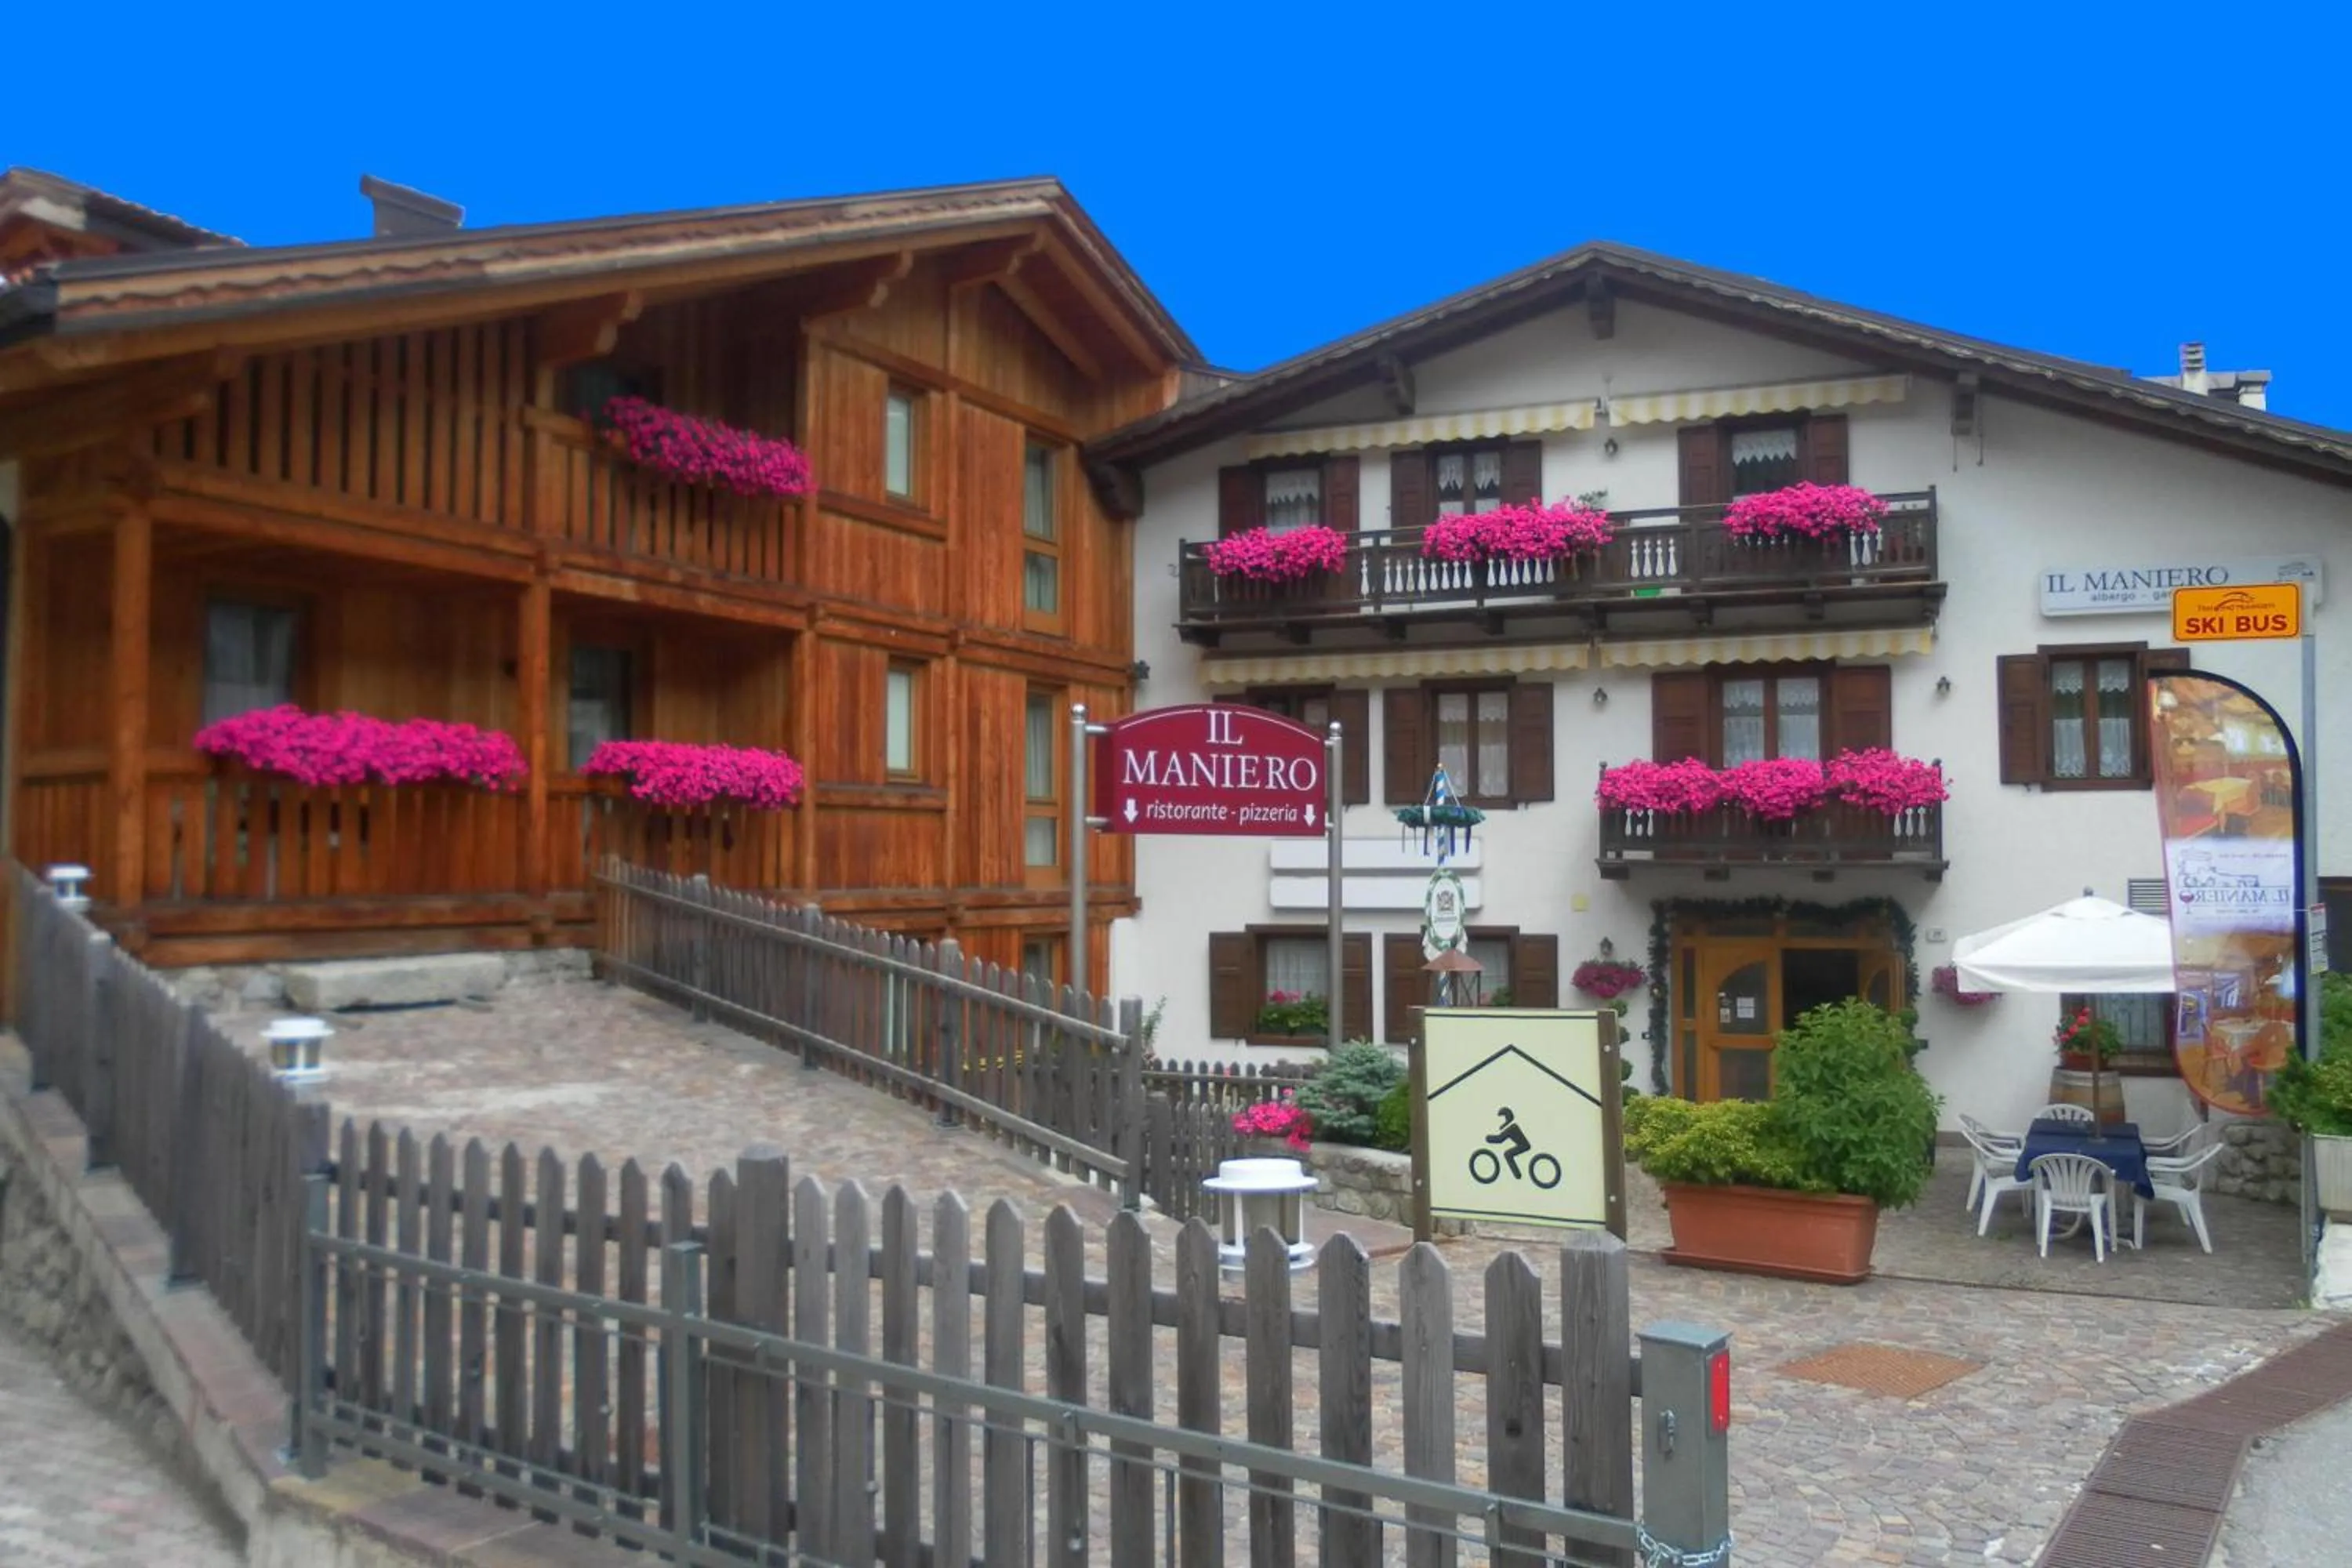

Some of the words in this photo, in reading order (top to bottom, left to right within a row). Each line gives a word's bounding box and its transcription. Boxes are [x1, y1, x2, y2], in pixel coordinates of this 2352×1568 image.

[2047, 574, 2075, 593] IL
[2082, 566, 2229, 591] MANIERO
[2090, 592, 2136, 602] albergo
[2185, 616, 2224, 634] SKI
[2235, 614, 2288, 632] BUS
[1206, 710, 1243, 745] IL
[1122, 750, 1317, 791] MANIERO
[1145, 800, 1227, 820] ristorante
[1239, 803, 1298, 825] pizzeria
